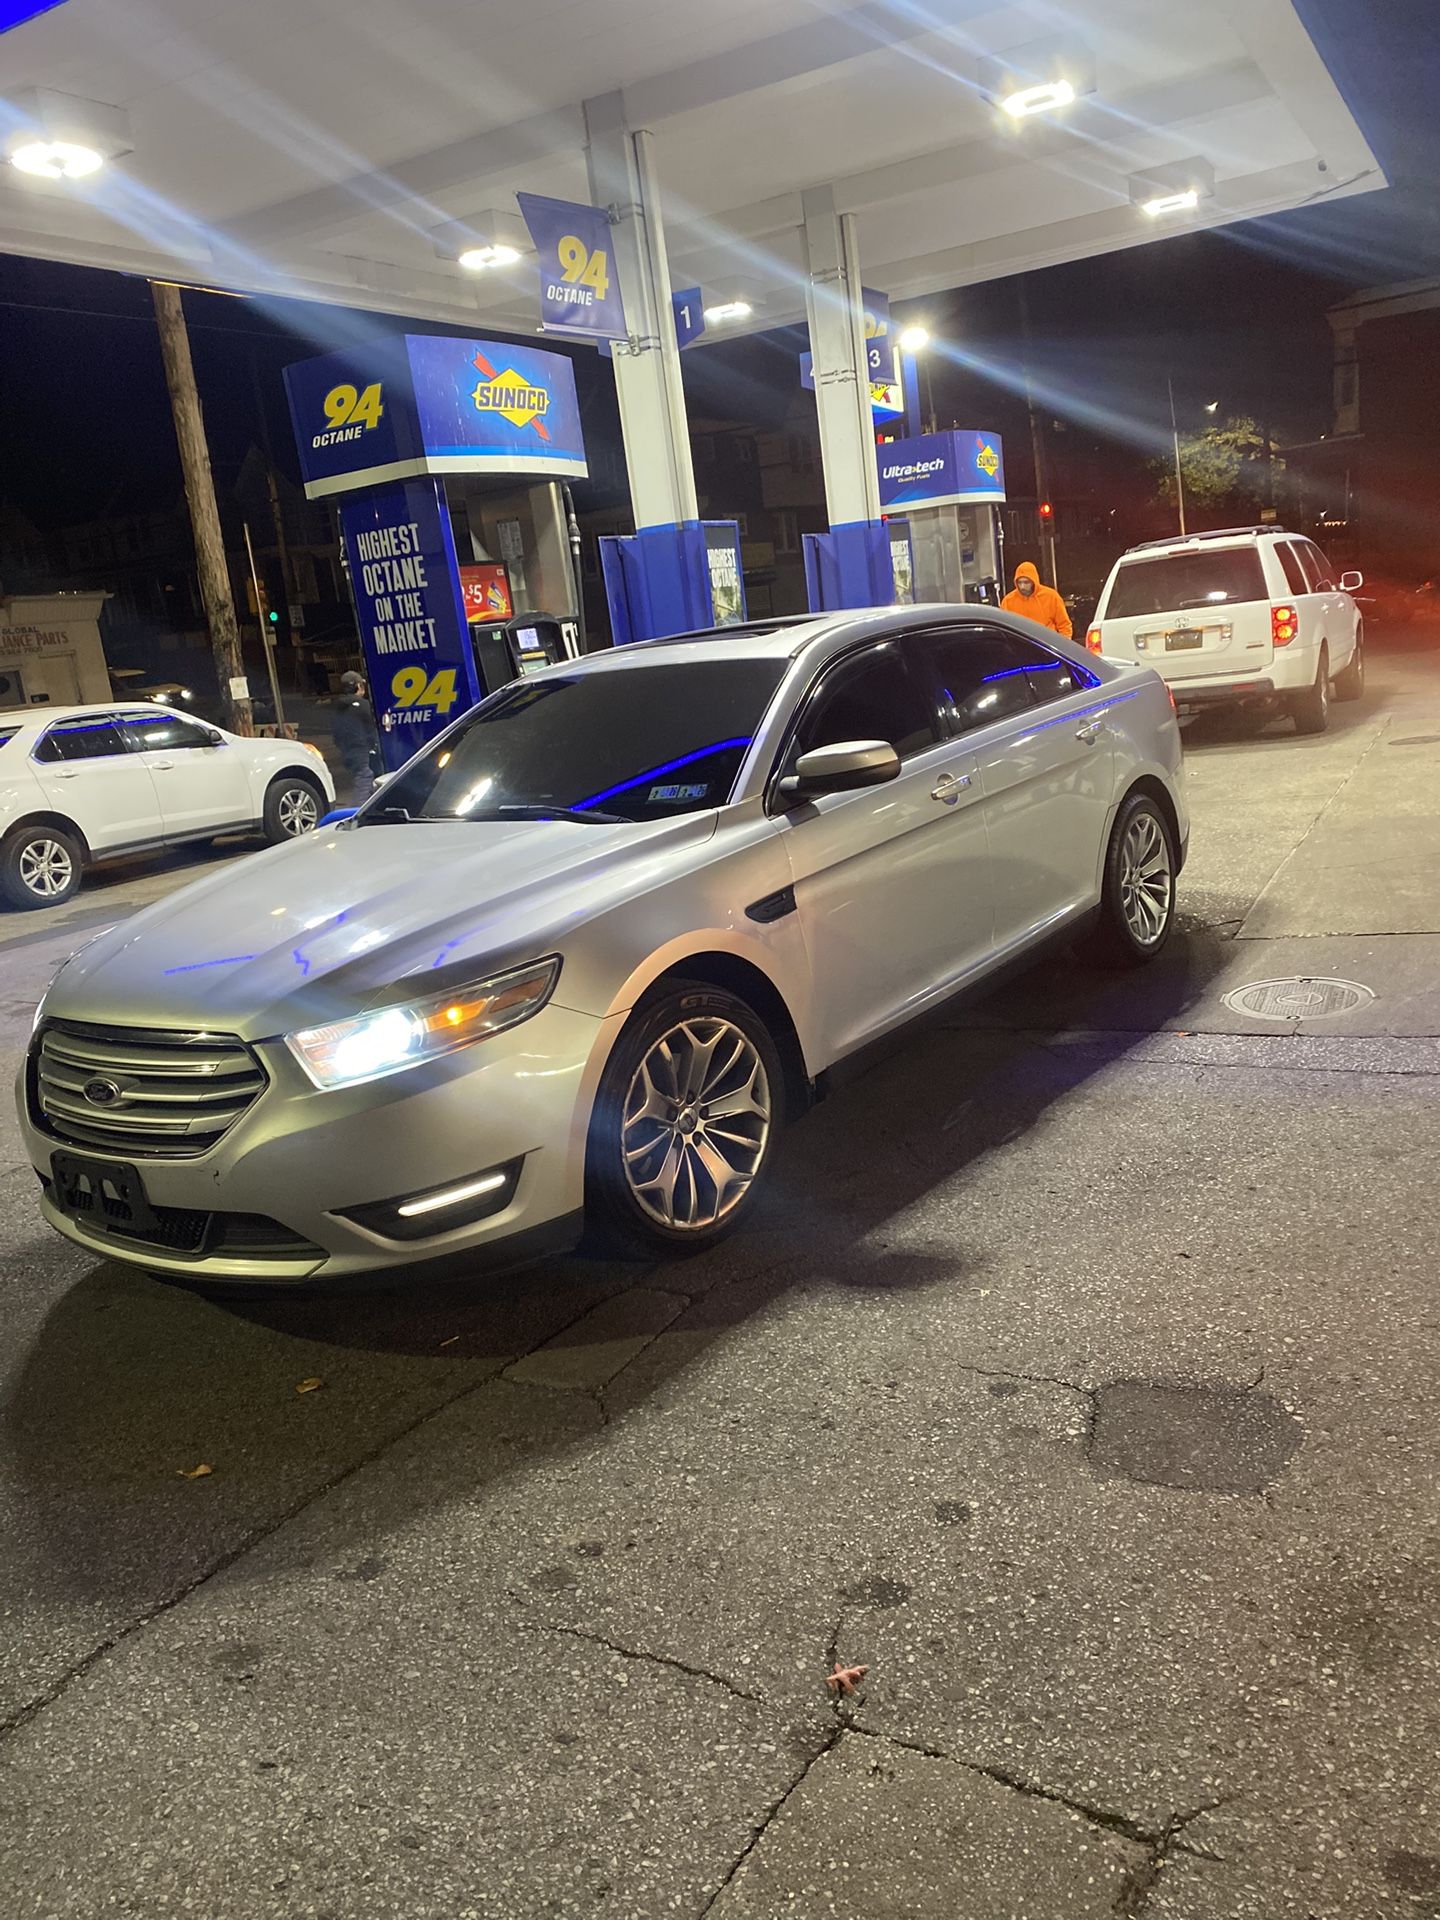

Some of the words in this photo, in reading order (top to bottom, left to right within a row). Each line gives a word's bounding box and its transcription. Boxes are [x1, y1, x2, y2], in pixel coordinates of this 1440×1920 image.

[558, 235, 609, 300] 94
[546, 285, 593, 306] OCTANE
[680, 306, 691, 329] 1
[869, 349, 881, 368] 3
[324, 383, 383, 429] 94
[478, 385, 546, 411] SUNOCO
[312, 426, 363, 448] OCTANE
[356, 523, 420, 561] HIGHEST
[362, 555, 428, 596] OCTANE
[375, 596, 394, 622] ON
[395, 592, 424, 619] THE
[2, 626, 39, 635] GLOBAL
[36, 631, 69, 646] PARTS
[373, 618, 437, 655] MARKET
[391, 666, 458, 714] 94
